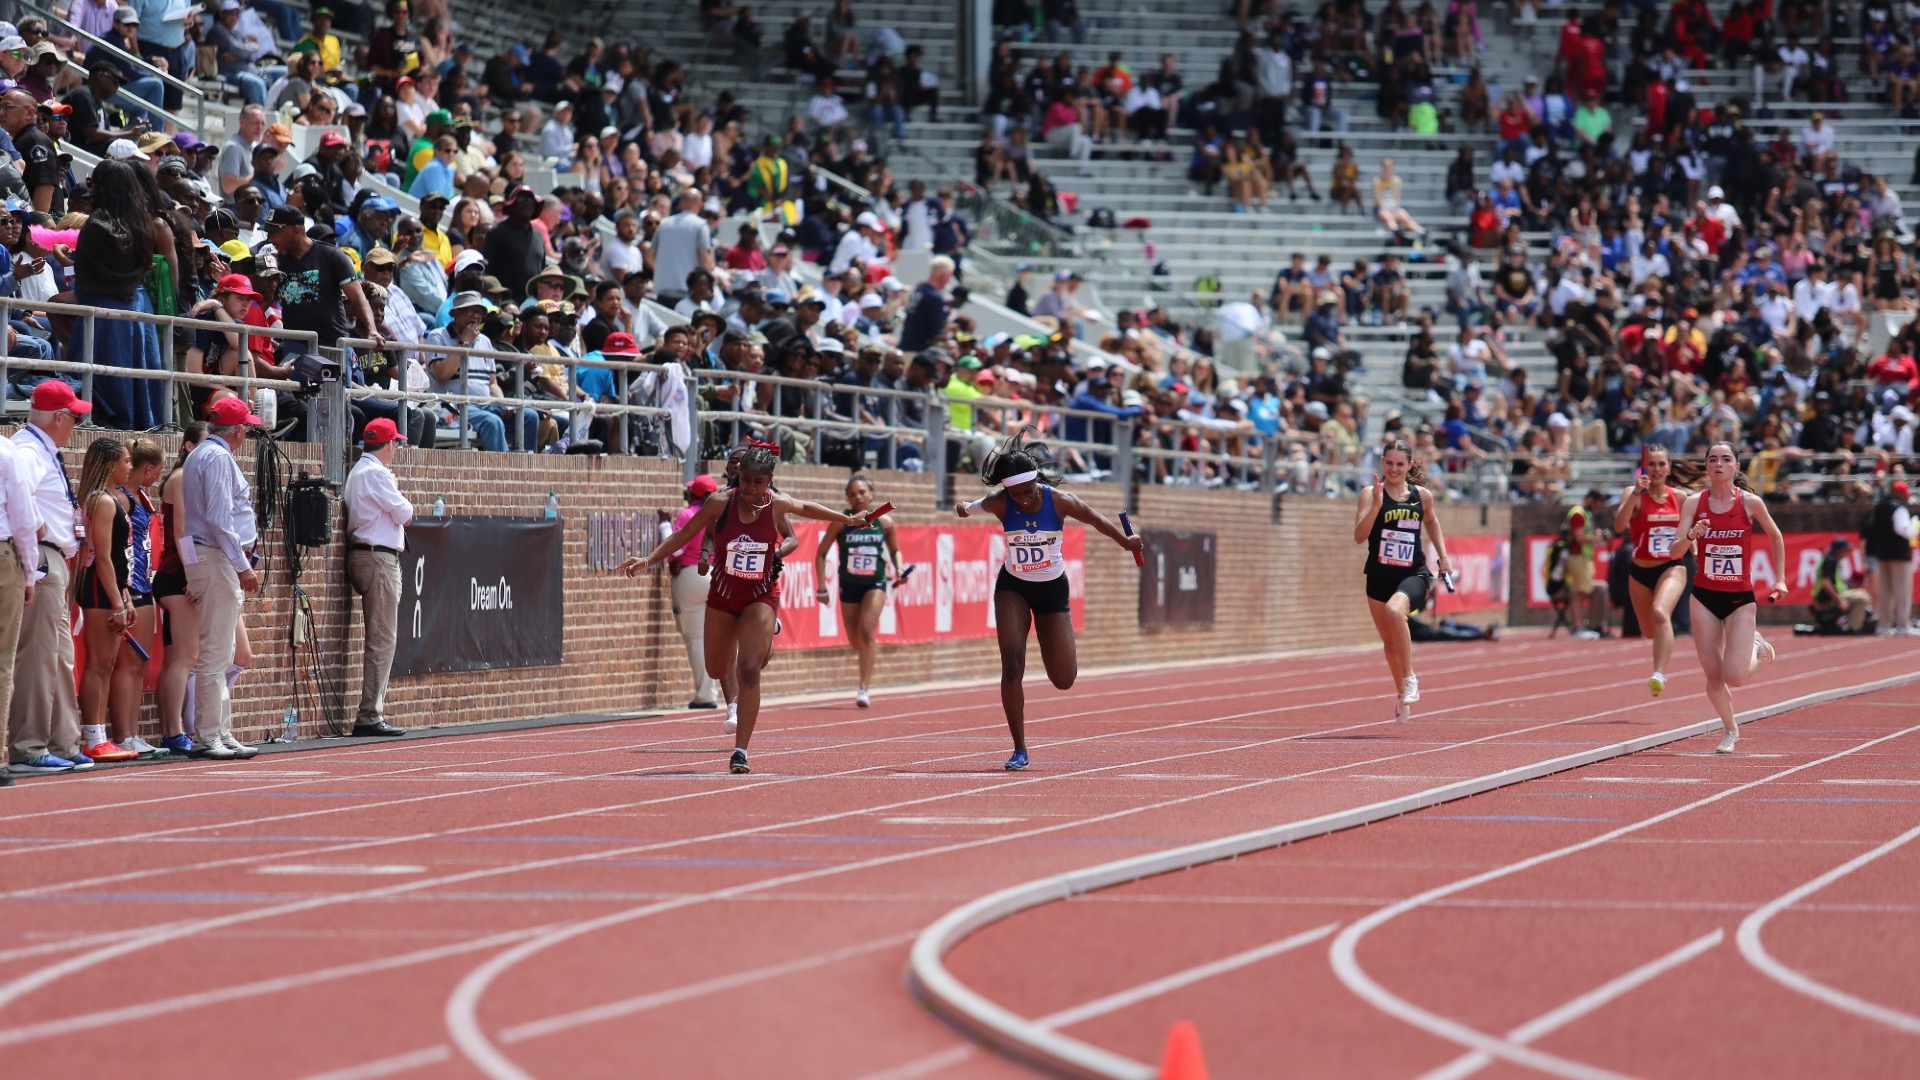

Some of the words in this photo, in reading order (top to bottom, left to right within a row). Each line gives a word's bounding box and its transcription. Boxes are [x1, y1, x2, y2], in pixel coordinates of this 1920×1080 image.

[1384, 508, 1420, 523] OWLS
[845, 534, 884, 543] DREW
[1016, 547, 1045, 564] DD
[1383, 542, 1413, 560] EW
[733, 553, 757, 571] EE
[853, 557, 872, 569] EP
[1023, 562, 1048, 570] TOYOTA
[1712, 559, 1736, 574] FA
[735, 571, 759, 579] TOYOTA
[778, 561, 815, 609] OYOTA
[471, 577, 497, 610] Dream
[499, 576, 513, 609] On.
